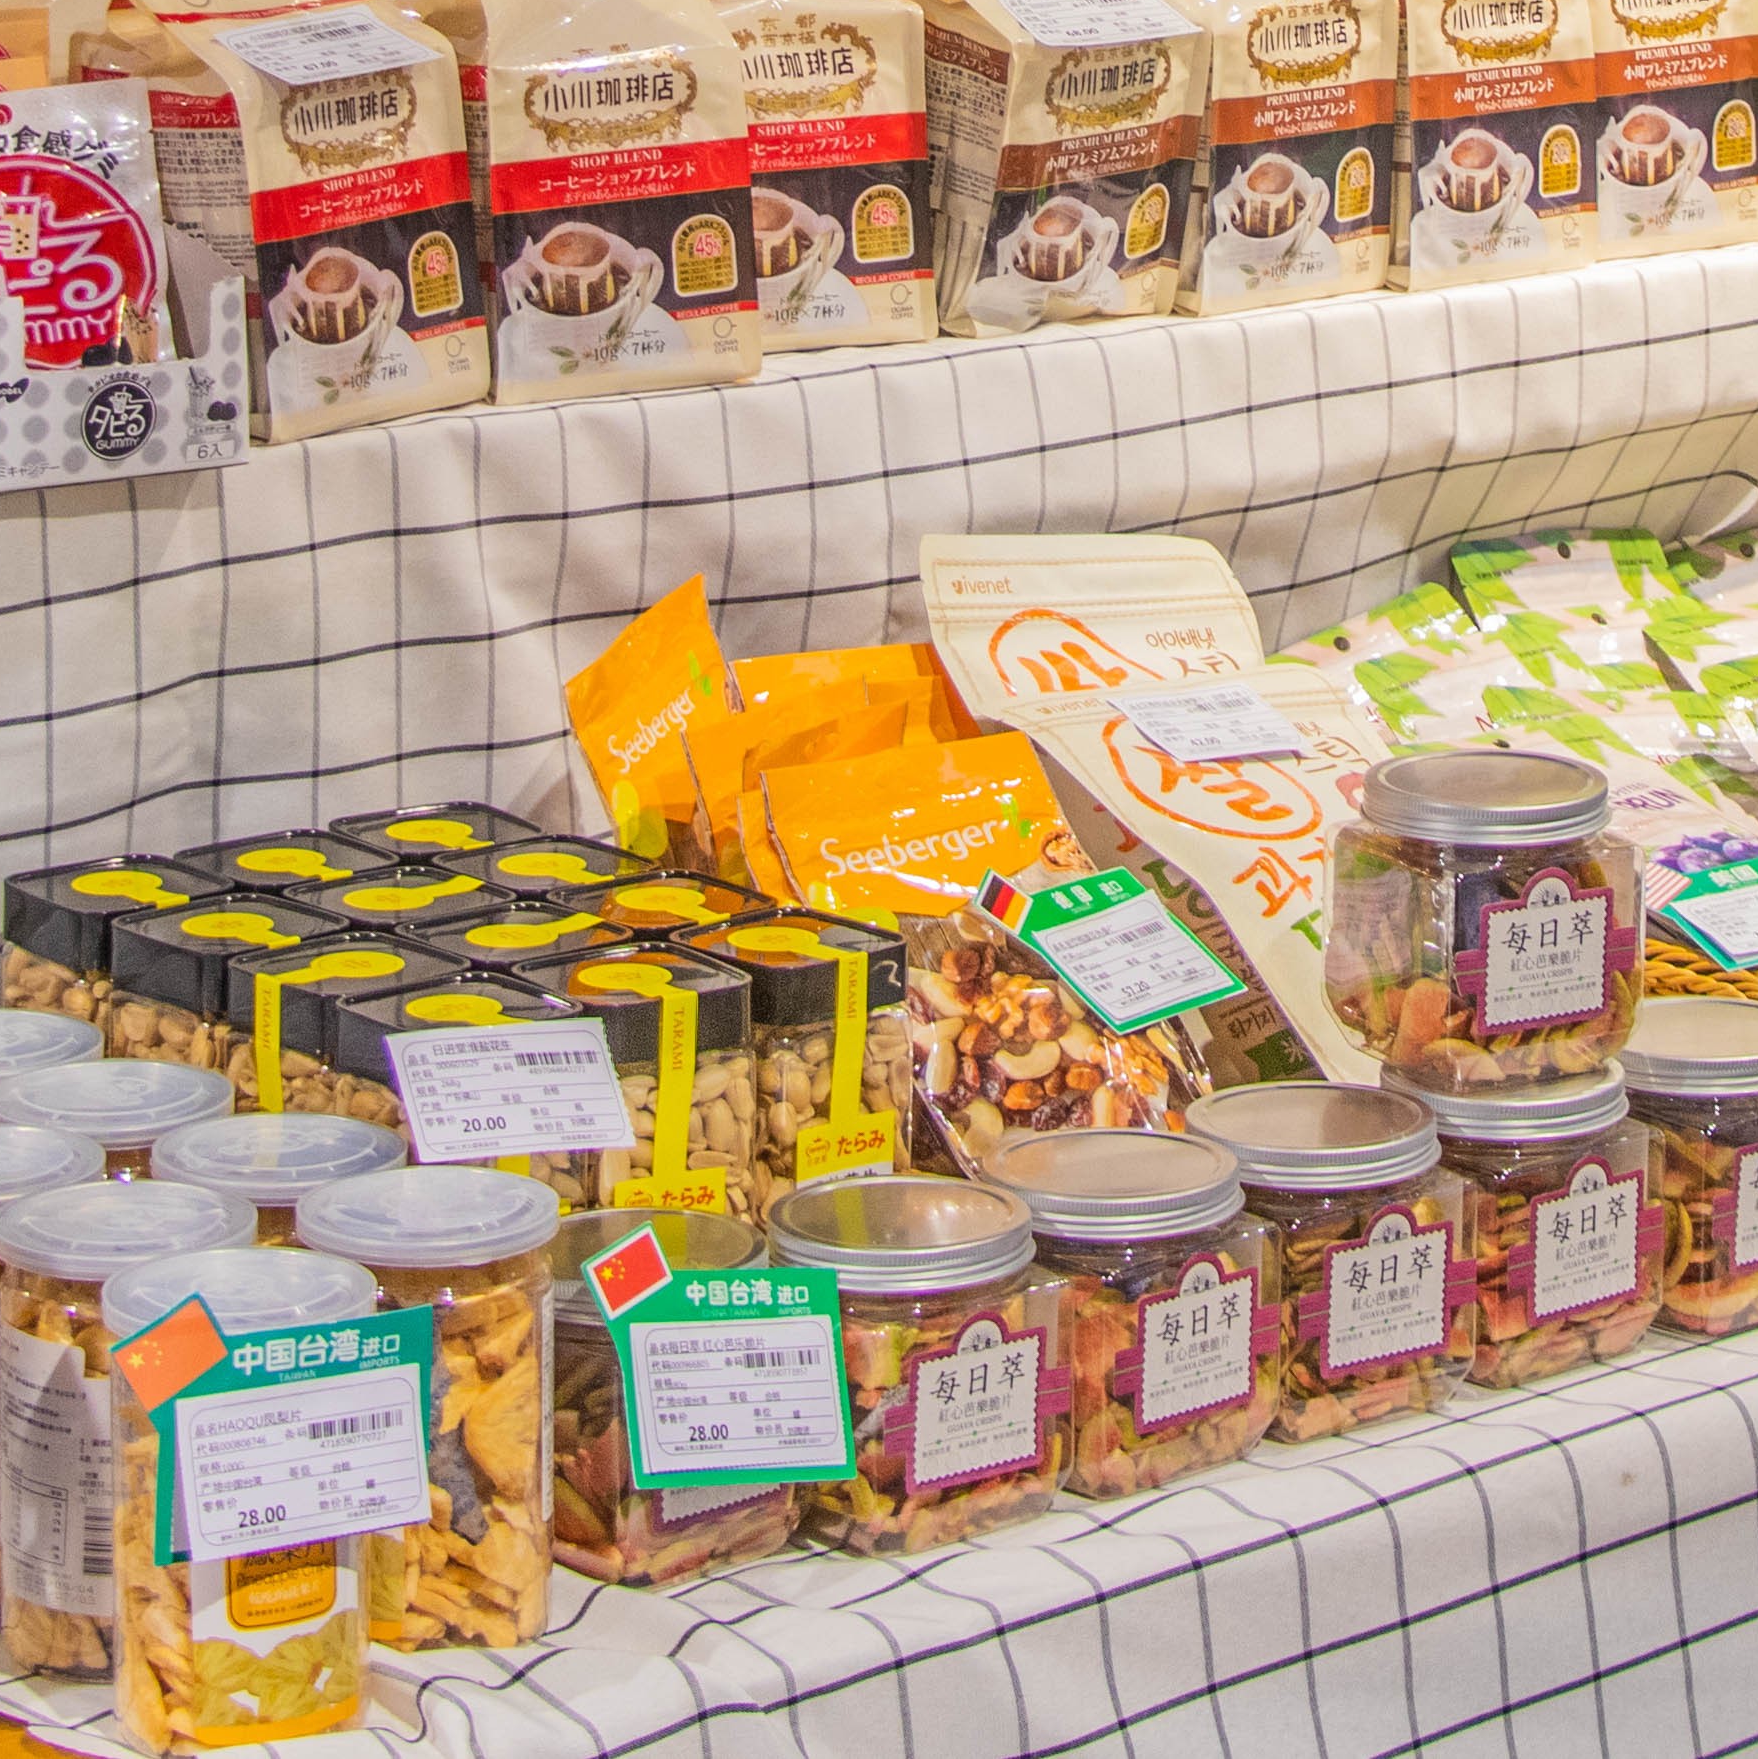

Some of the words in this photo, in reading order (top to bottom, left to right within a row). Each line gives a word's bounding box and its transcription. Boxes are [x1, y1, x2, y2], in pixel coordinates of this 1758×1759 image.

[1258, 22, 1350, 56] 小川珈琲店
[1634, 47, 1672, 63] PREMIUM
[1672, 42, 1713, 58] BLEND
[1058, 63, 1158, 97] 小川珈琲店
[1465, 68, 1506, 86] PREMIUM
[1505, 63, 1544, 80] BLEND
[1623, 52, 1729, 83] 小川プレミアムブレンド
[543, 73, 675, 113] 小川珈琲店
[1265, 91, 1308, 108] PREMIUM
[1308, 85, 1347, 102] BLEND
[1452, 75, 1556, 106] 小川プレミアムブレンド
[293, 92, 401, 137] 小川珈琲店
[756, 121, 795, 138] SHOP
[796, 117, 846, 135] BLEND
[1252, 97, 1357, 128] 小川プレミアムブレンド
[1045, 137, 1160, 173] 小川プレミアムブレンド
[1059, 132, 1108, 152] PREMIUM
[1108, 127, 1151, 144] BLEND
[570, 150, 614, 171] SHOP
[615, 146, 663, 168] BLEND
[322, 171, 353, 194] SHOP
[353, 165, 397, 188] BLEND
[538, 160, 697, 194] コーヒーショップブレンド
[296, 176, 424, 216] コーヒーショップブレンド
[872, 204, 900, 227] 45%
[694, 233, 721, 259] 45%
[95, 438, 140, 450] GUMMY
[197, 443, 223, 459] 6入
[606, 685, 697, 775] Seeberger
[818, 818, 1003, 882] Seeberger
[1502, 909, 1595, 957] 每日萃
[843, 956, 860, 1021] TARAMI
[671, 1004, 686, 1073] TARAMI
[462, 1115, 507, 1133] 20.00
[836, 1123, 889, 1155] たらみ
[660, 1185, 717, 1210] たらみ
[1550, 1201, 1630, 1246] 每日萃
[1341, 1247, 1434, 1295] 每日萃
[686, 1278, 773, 1306] 中国台湾
[777, 1286, 809, 1304] 进口
[1155, 1292, 1243, 1349] 每日萃
[233, 1328, 361, 1376] 中国台湾
[361, 1334, 400, 1358] 进口
[359, 1356, 400, 1369] IMPORTS
[928, 1351, 1027, 1407] 每日萃
[688, 1424, 729, 1442] 28.00
[238, 1505, 287, 1528] 28.00
